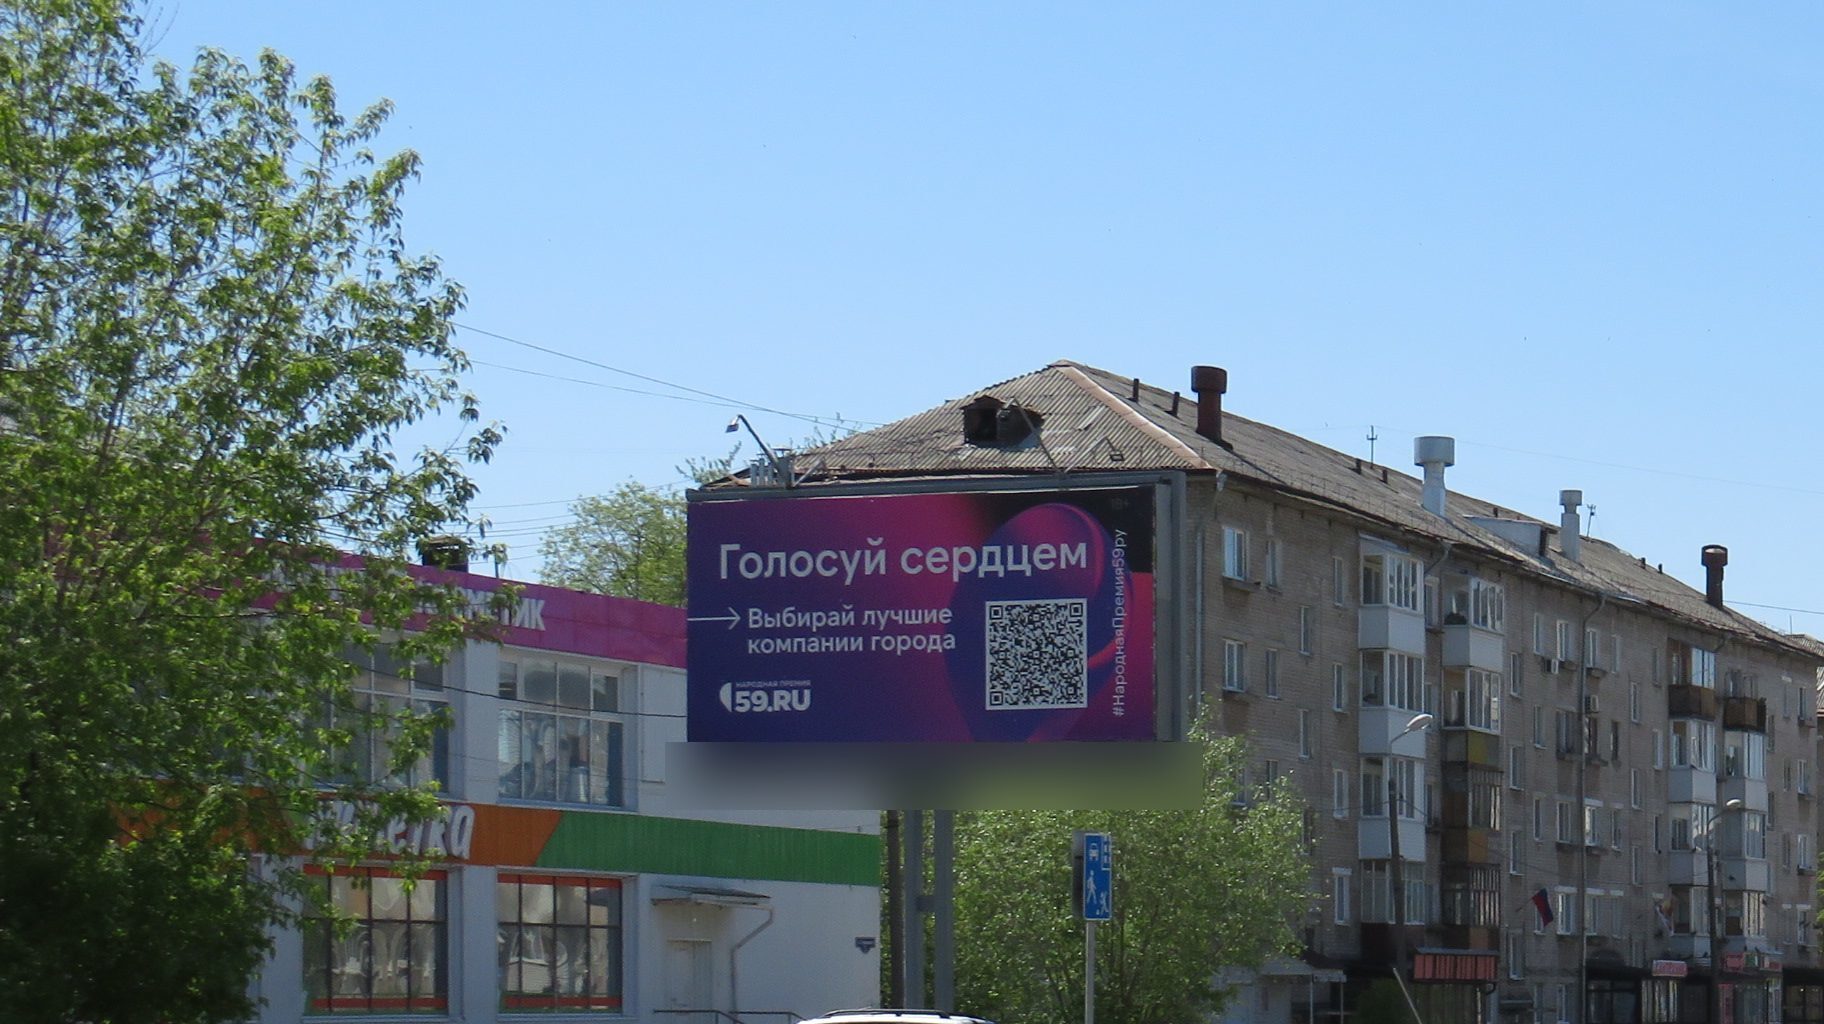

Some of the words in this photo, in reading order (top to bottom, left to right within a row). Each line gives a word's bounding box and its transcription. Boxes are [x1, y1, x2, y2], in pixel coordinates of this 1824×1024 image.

[720, 537, 886, 586] Голосуй
[900, 542, 1087, 583] сердцем
[748, 604, 854, 632] Выбирай
[862, 607, 953, 630] лучшие
[748, 635, 863, 654] компании
[871, 633, 956, 656] города
[735, 689, 811, 713] 59.RU
